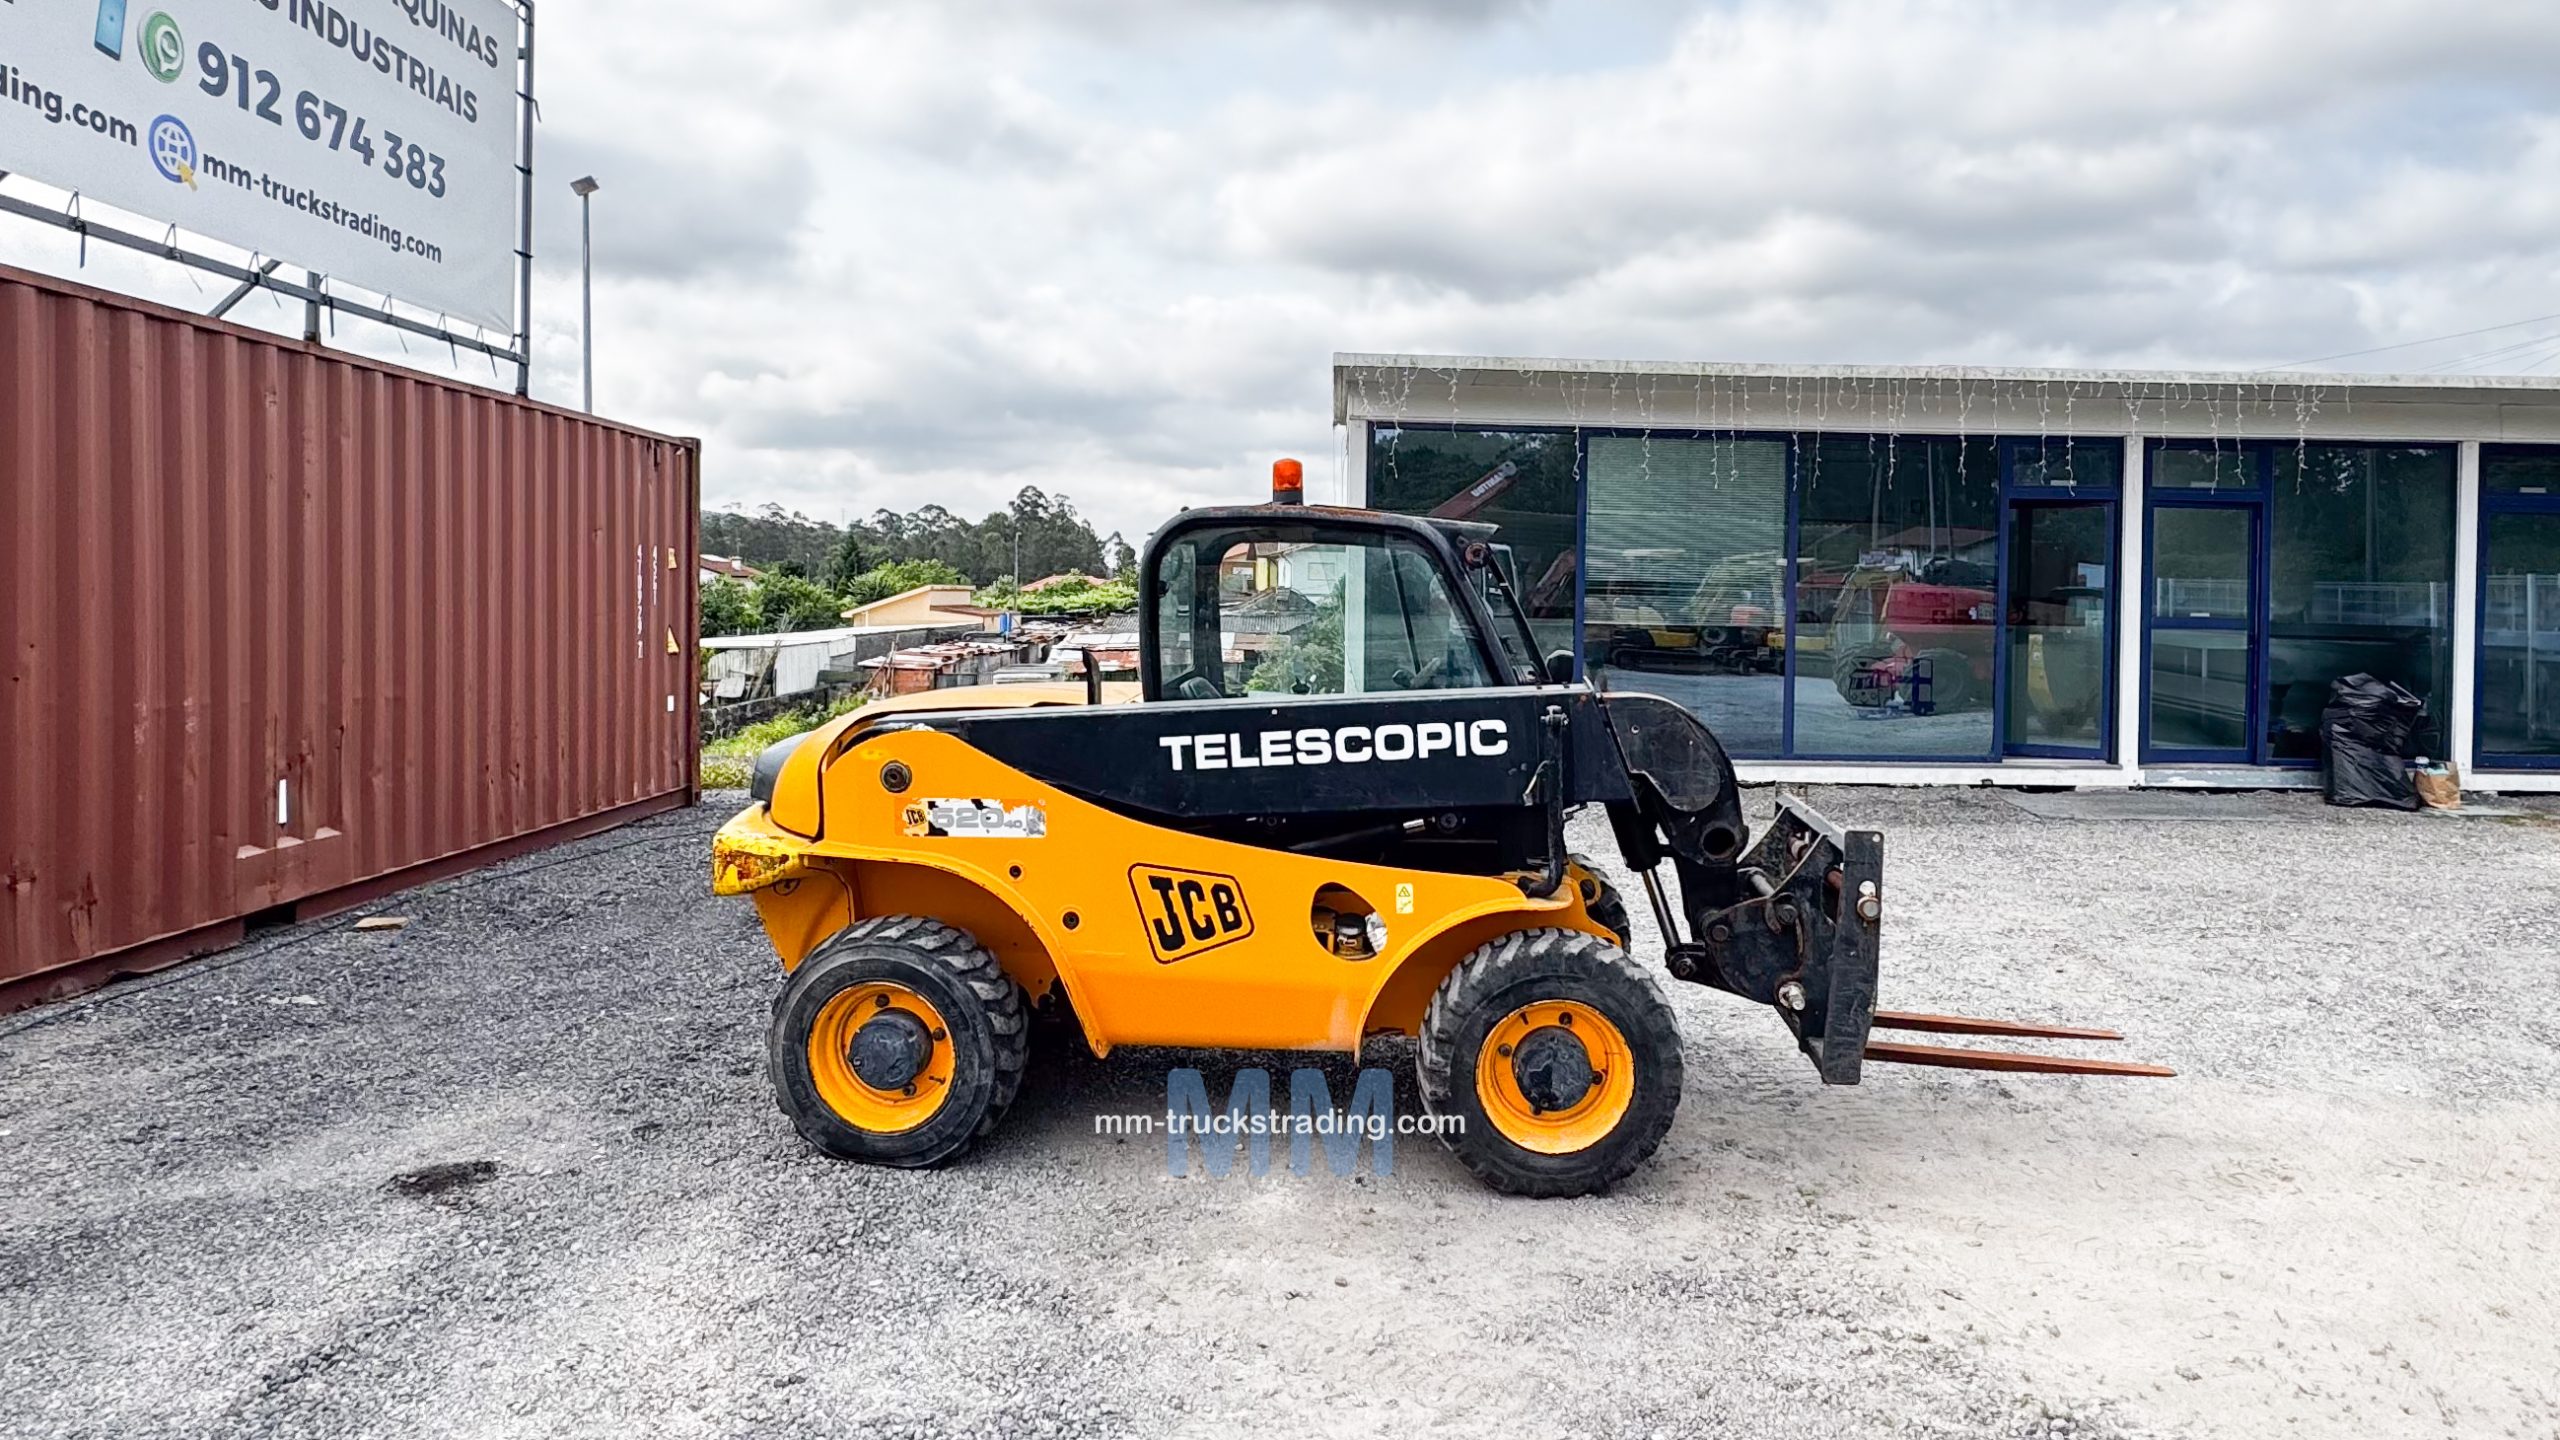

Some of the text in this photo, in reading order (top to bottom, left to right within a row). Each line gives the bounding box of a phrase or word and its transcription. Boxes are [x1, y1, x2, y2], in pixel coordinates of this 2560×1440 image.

[289, 0, 477, 123] INDUSTRIAIS
[391, 0, 498, 69] QUINAS
[198, 41, 447, 199] 912 674 383
[202, 152, 443, 264] mm-truckstrading.com
[1159, 719, 1508, 771] TELESCOPIC
[905, 809, 926, 826] JCB
[1147, 874, 1243, 952] JCB
